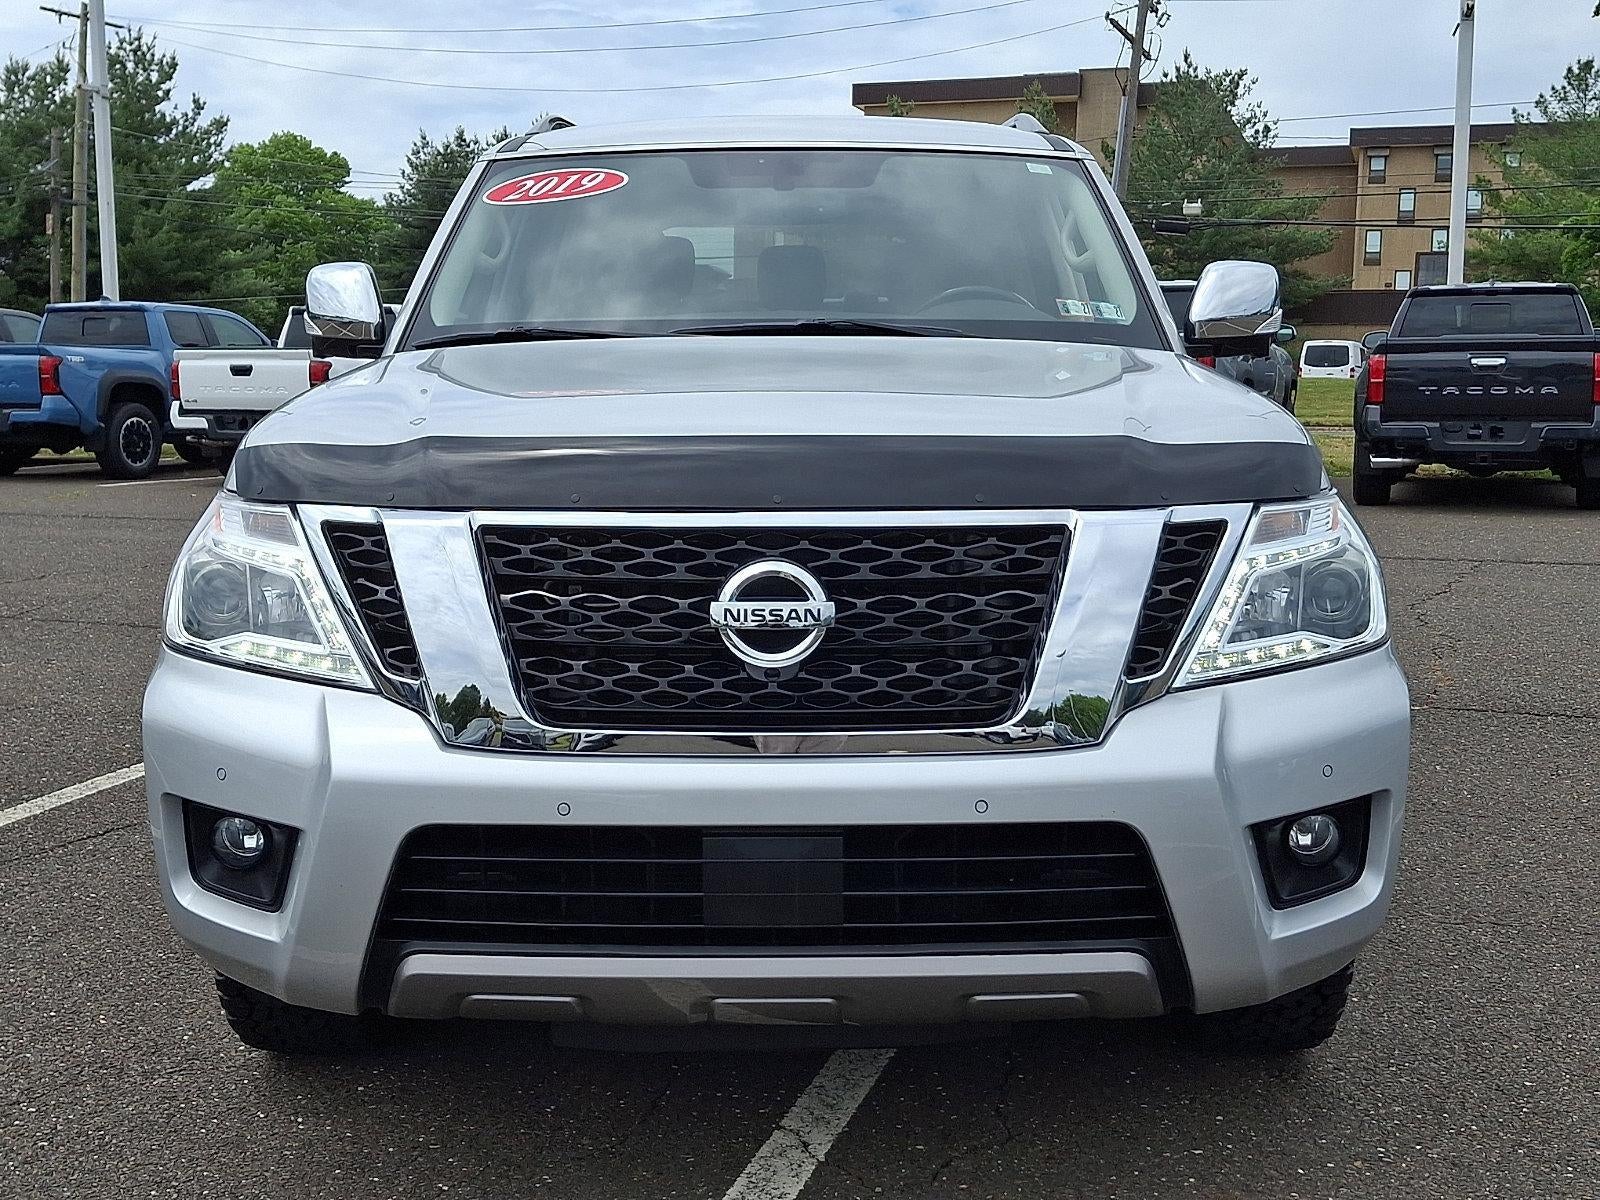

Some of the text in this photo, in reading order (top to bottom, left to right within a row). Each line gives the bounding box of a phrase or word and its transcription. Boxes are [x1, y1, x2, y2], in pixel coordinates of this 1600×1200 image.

[502, 172, 606, 202] 2019
[199, 385, 289, 394] TACOMA
[1418, 386, 1559, 395] TACOMA
[723, 607, 821, 623] NISSAN
